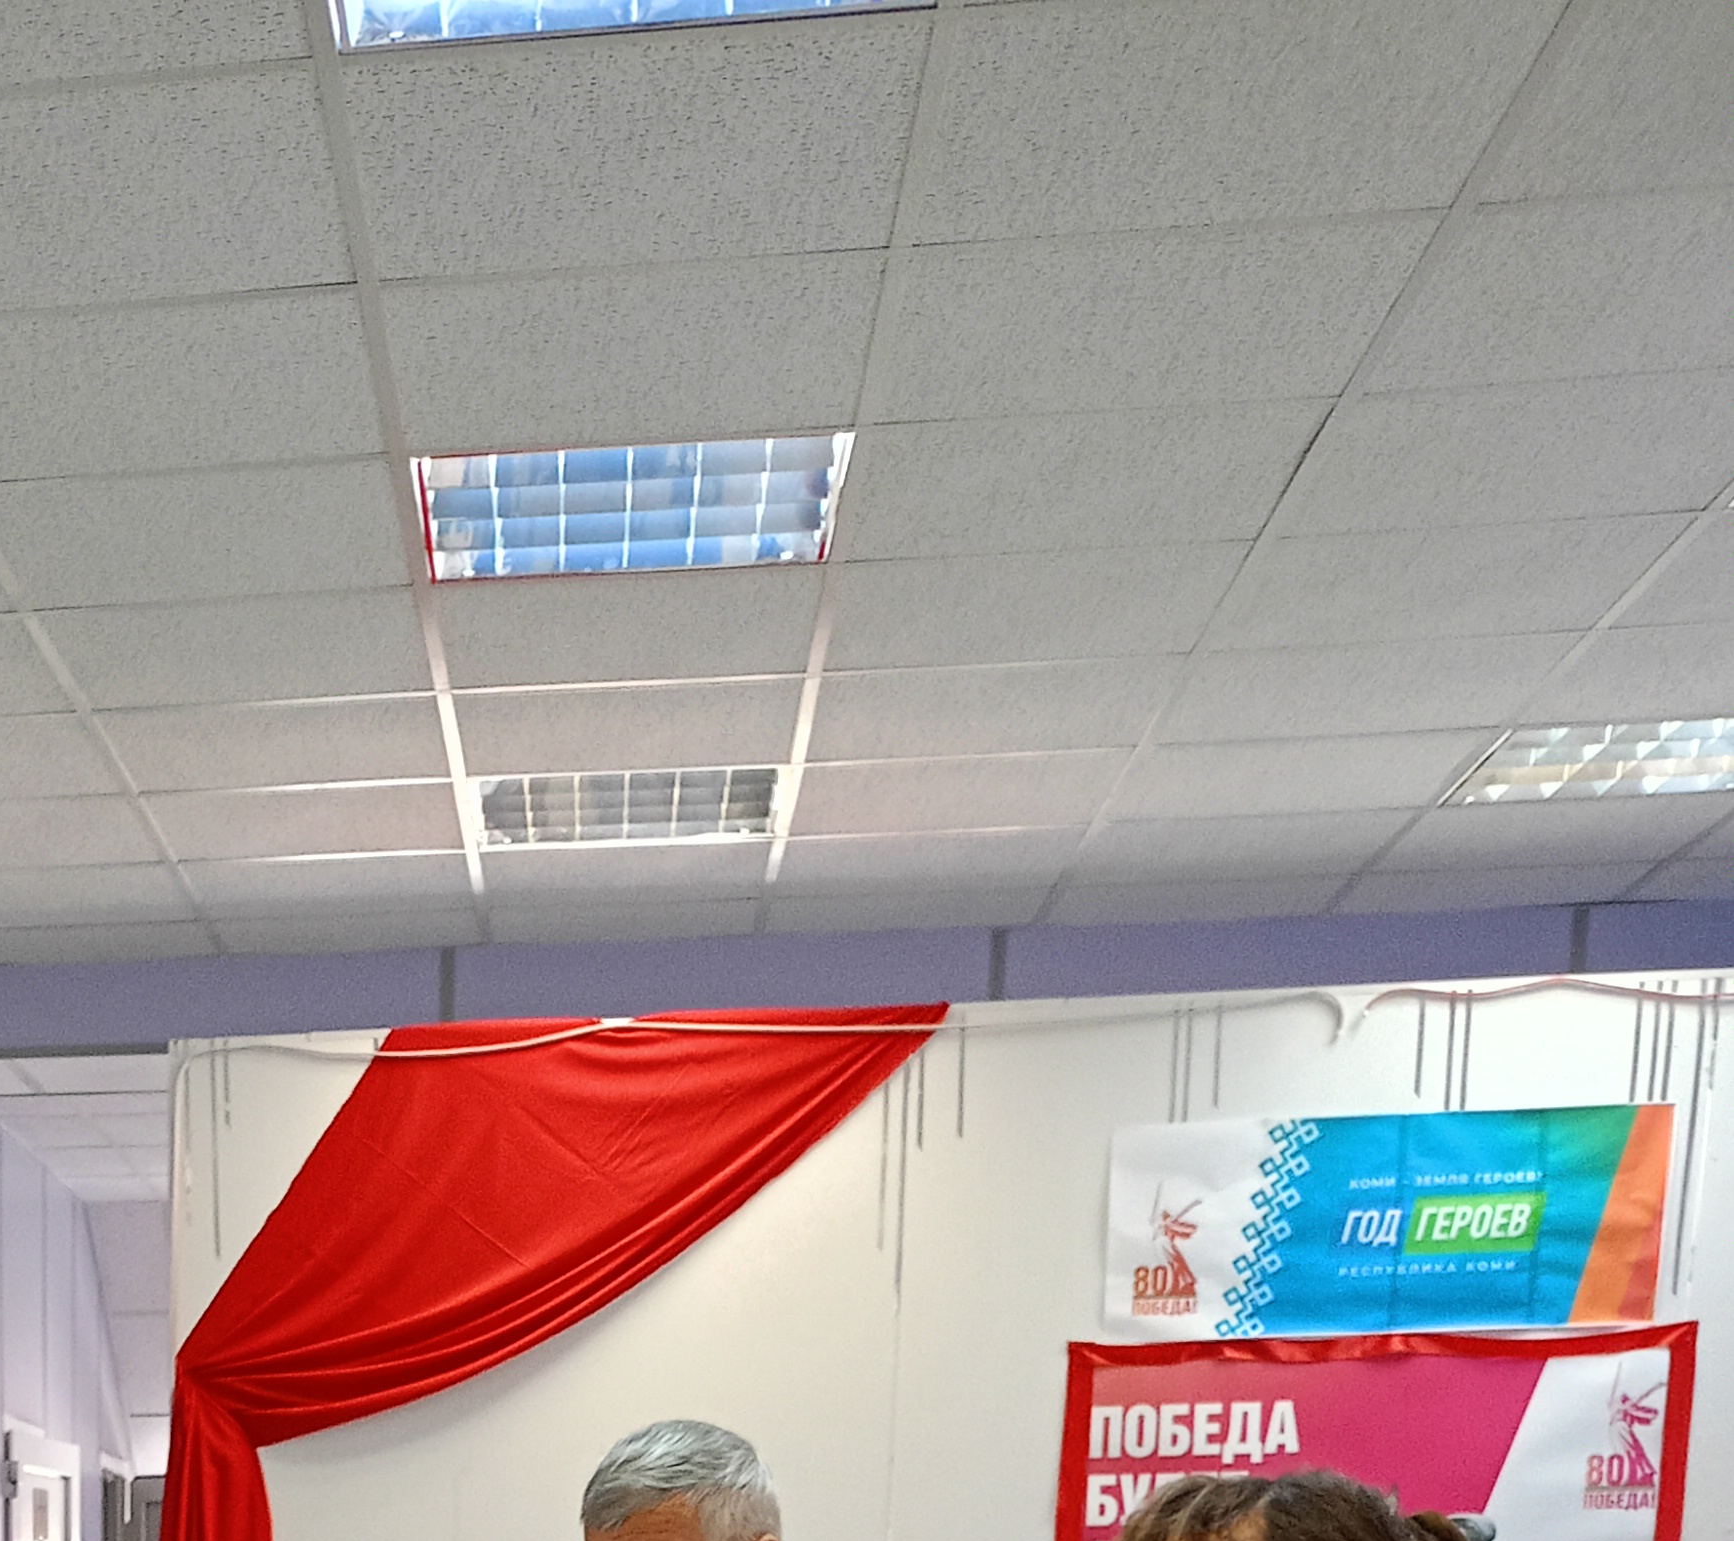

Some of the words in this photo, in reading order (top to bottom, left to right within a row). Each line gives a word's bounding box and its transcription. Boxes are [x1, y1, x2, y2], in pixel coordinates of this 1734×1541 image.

[1349, 1177, 1396, 1190] КОМИ
[1415, 1174, 1469, 1187] ЗЕМЛЯ
[1341, 1209, 1403, 1247] ГОД
[1415, 1203, 1532, 1242] ГЕРОЕВ
[1133, 1265, 1168, 1296] 80
[1338, 1261, 1457, 1277] РЕСПУБЛИКА
[1465, 1260, 1517, 1273] КОМИ
[1131, 1299, 1197, 1316] ПОБЕДА!
[1089, 1399, 1300, 1464] ПОБЕДА
[1586, 1453, 1625, 1487] 80
[1583, 1492, 1656, 1511] ПОБЕДА!
